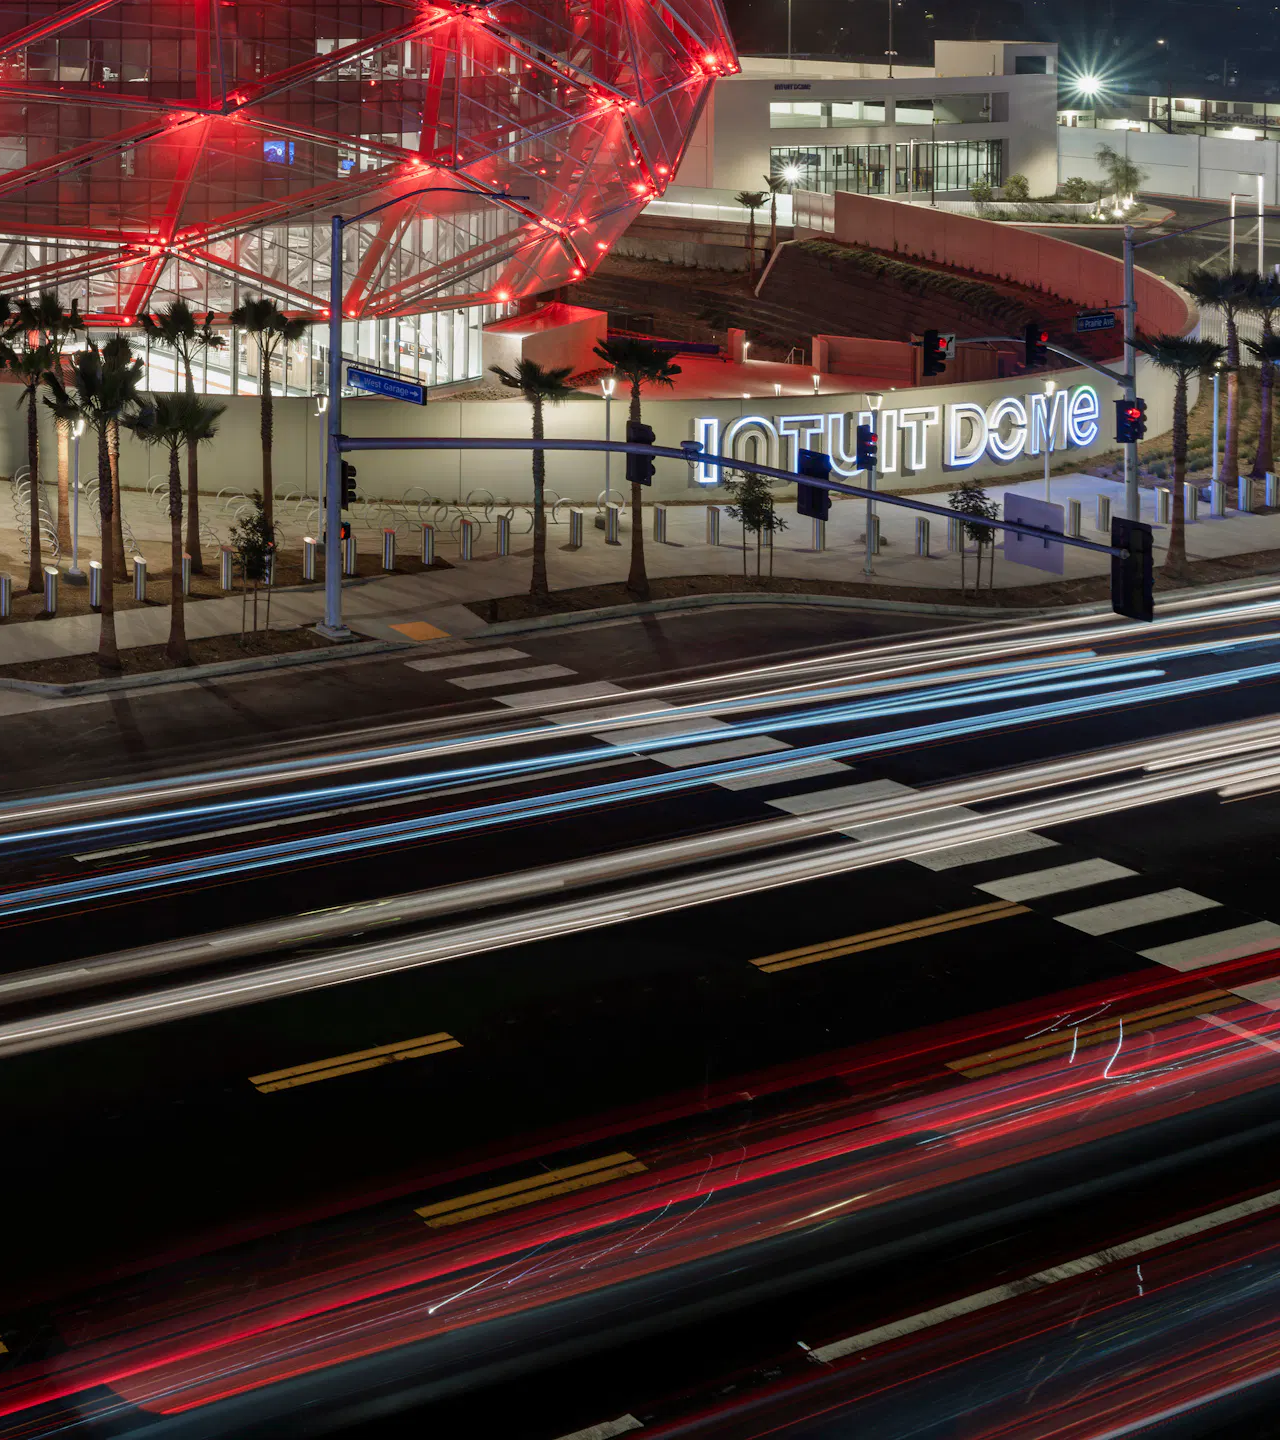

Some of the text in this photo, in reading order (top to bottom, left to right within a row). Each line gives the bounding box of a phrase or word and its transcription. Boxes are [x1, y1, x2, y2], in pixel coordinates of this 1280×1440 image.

[1085, 318, 1102, 328] Prairie
[363, 377, 409, 396] West Garage
